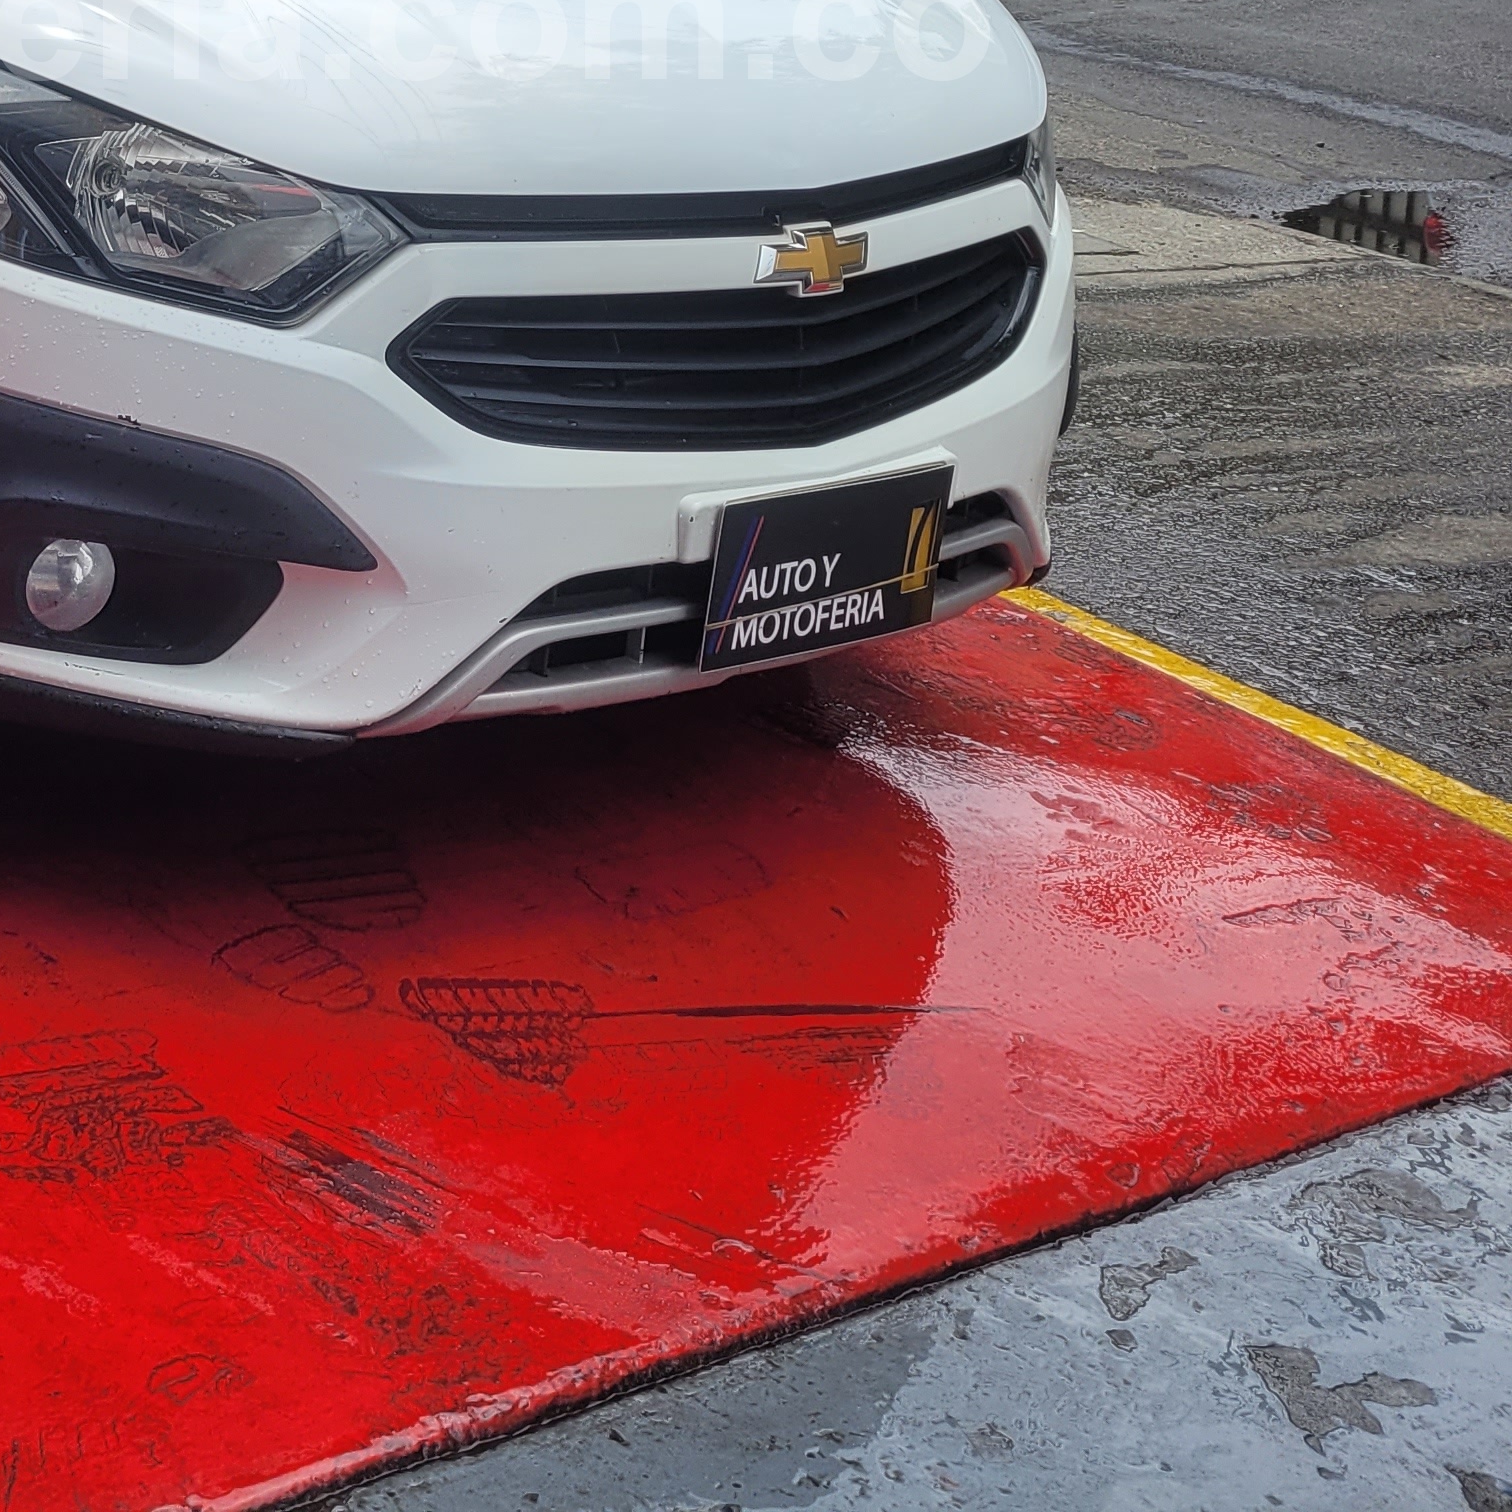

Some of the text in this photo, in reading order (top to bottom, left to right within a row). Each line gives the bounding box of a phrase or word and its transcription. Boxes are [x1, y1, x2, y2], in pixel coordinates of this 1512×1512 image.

[738, 553, 841, 604] AUTO Y
[731, 589, 885, 650] MOTOFERIA
